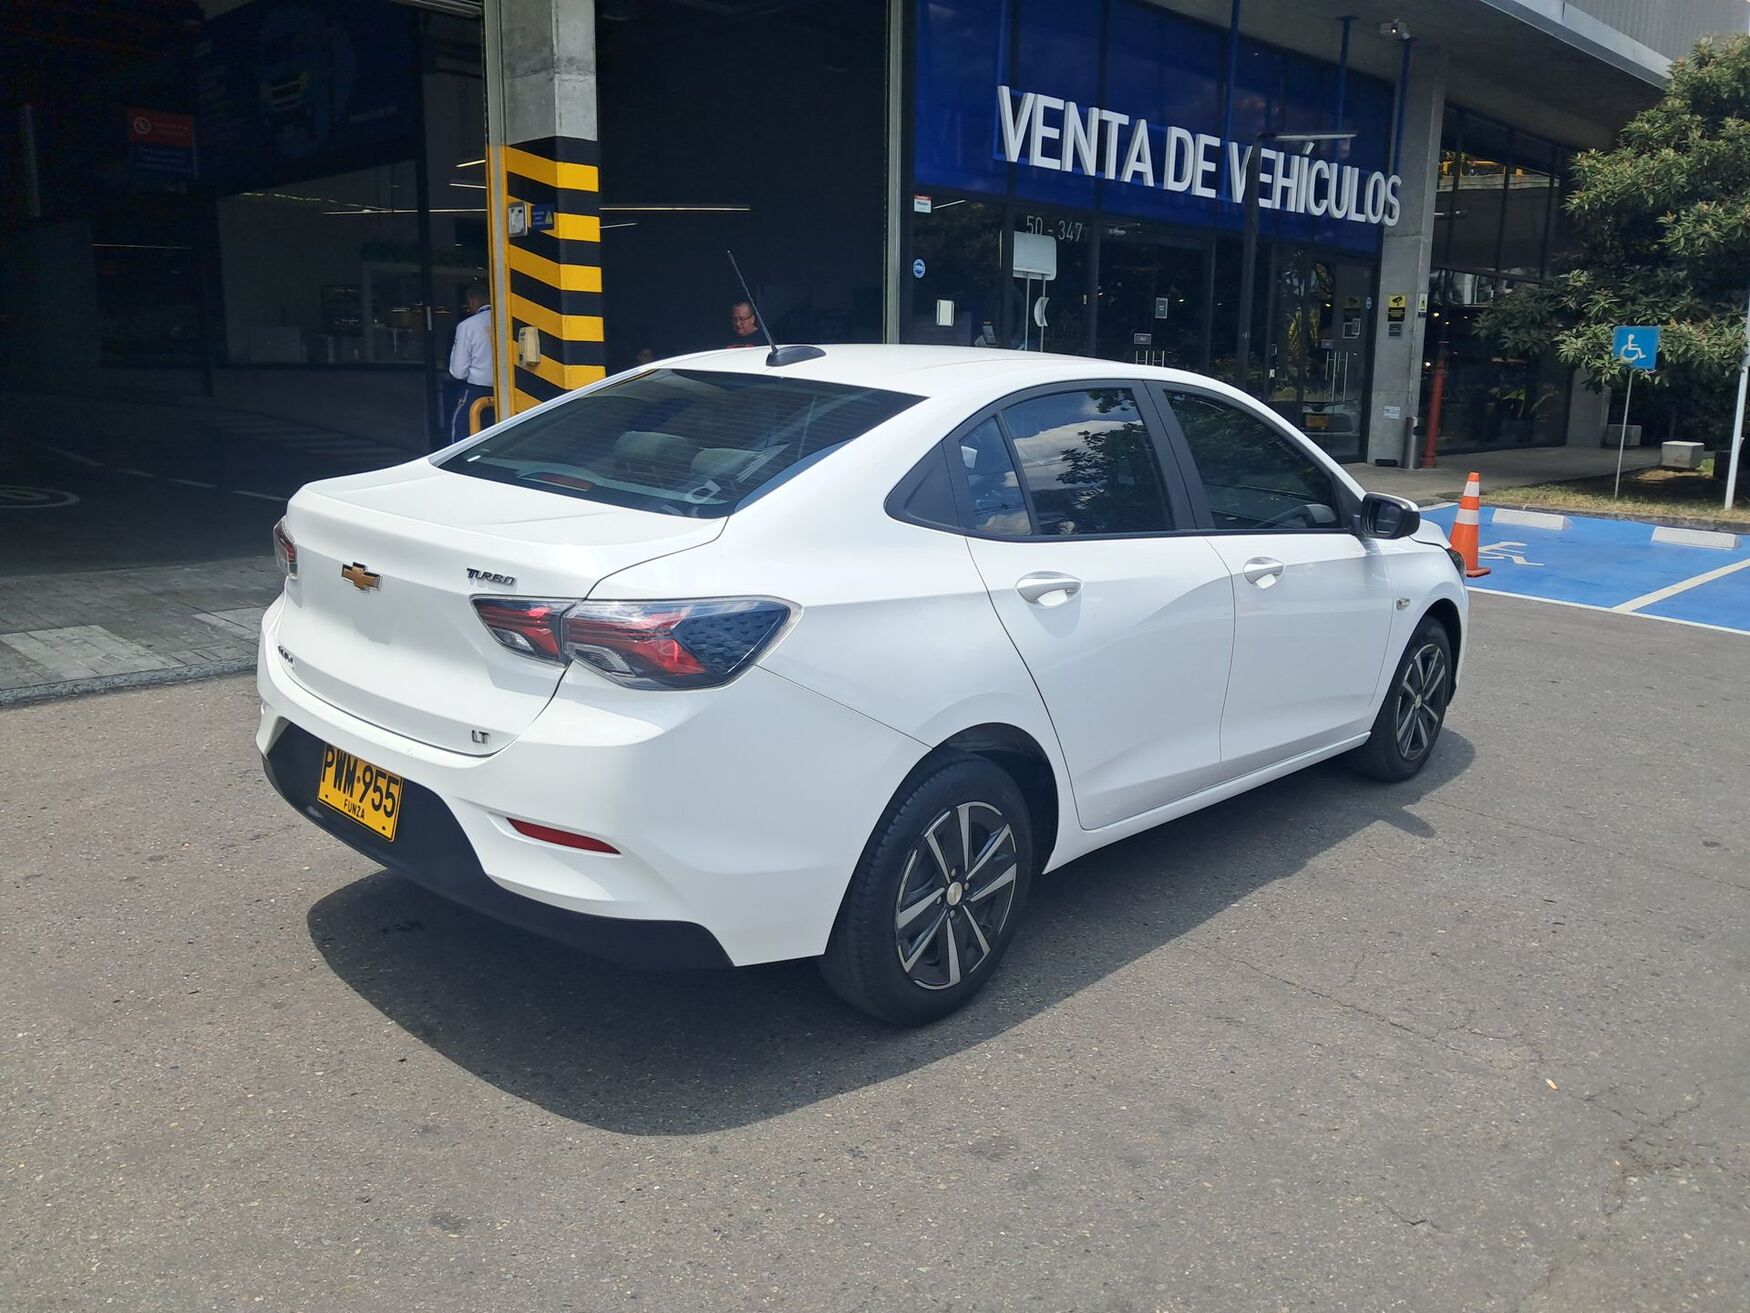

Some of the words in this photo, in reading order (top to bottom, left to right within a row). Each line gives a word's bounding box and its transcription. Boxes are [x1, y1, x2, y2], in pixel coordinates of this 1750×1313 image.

[997, 85, 1155, 187] VENTA
[1164, 126, 1221, 199] DE
[1228, 141, 1402, 227] VEHÍCULOS
[1058, 219, 1083, 242] 347
[466, 567, 517, 587] TURBO
[471, 729, 489, 745] LT
[343, 798, 366, 821] FUNZA
